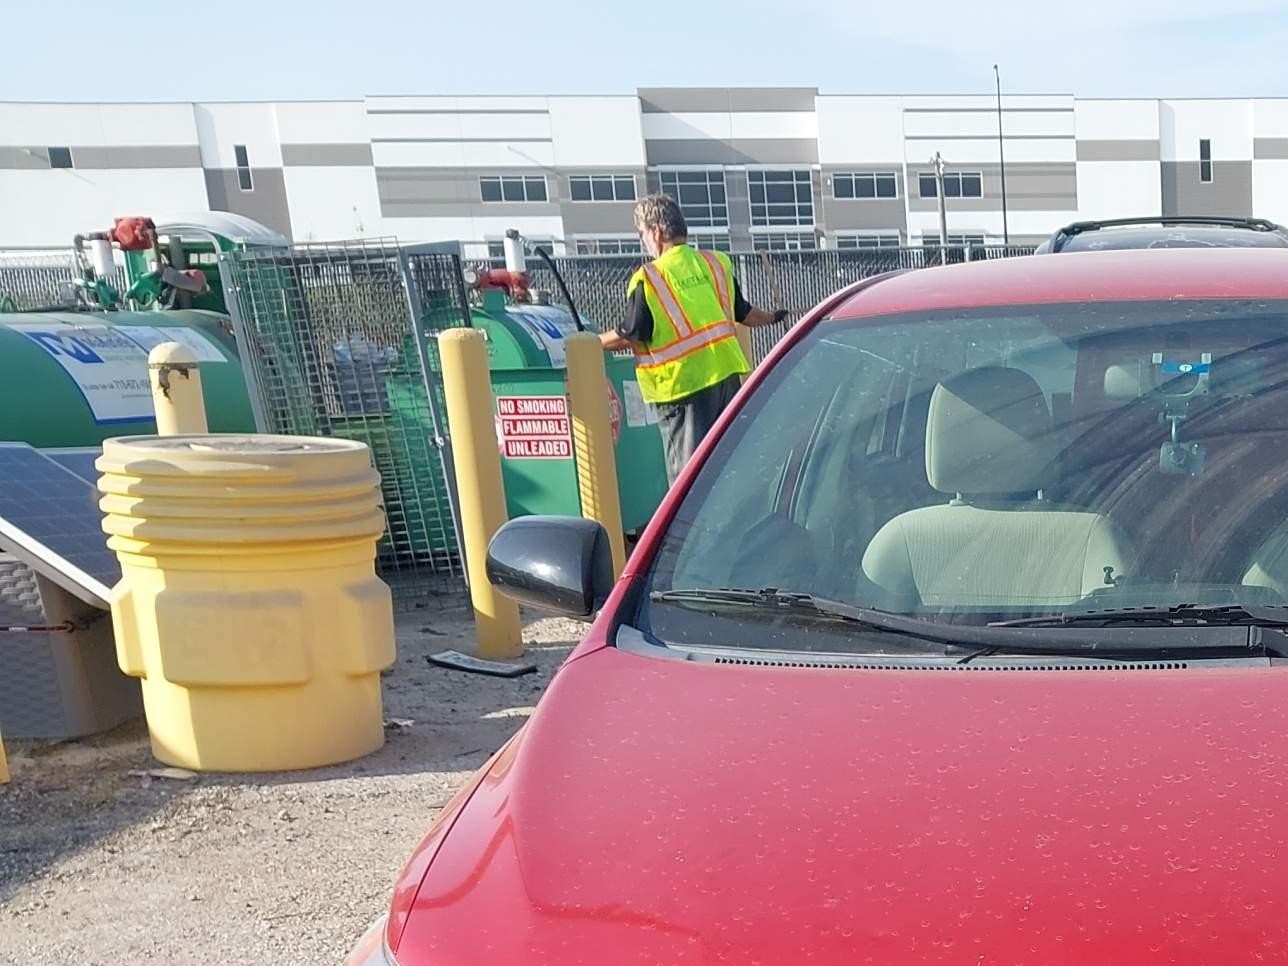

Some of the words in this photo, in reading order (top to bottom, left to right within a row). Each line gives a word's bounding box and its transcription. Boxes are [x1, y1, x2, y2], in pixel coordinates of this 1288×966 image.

[500, 400, 515, 414] NO
[517, 400, 564, 414] SMOKING
[503, 420, 568, 435] FLAMMABLE
[507, 440, 569, 456] UNLEADED
